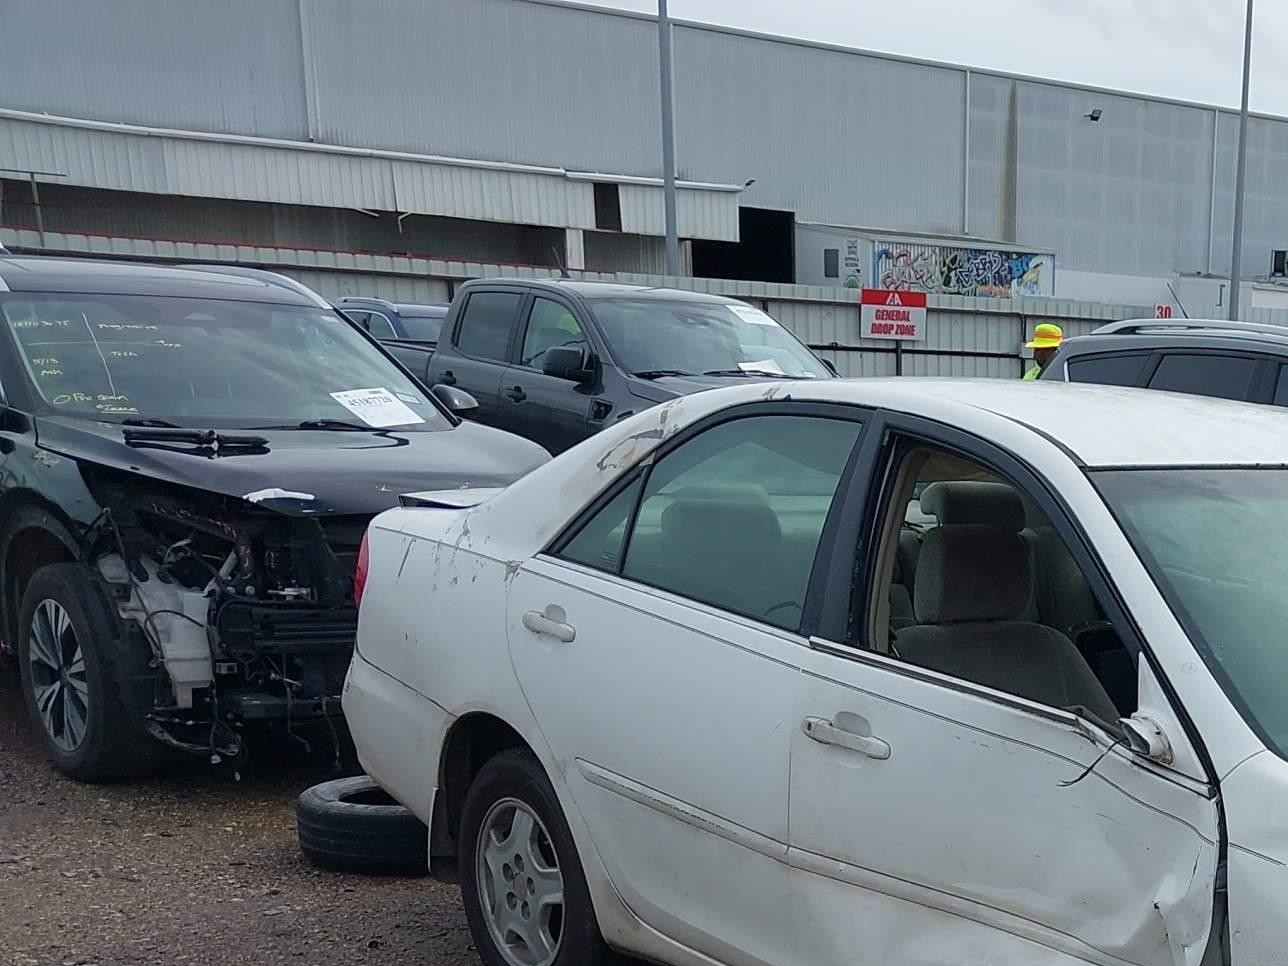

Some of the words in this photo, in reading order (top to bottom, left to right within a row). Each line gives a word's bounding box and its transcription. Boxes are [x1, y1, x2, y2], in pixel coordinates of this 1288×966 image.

[875, 309, 910, 321] GENERAL
[1157, 305, 1171, 319] 30
[871, 322, 895, 335] DROP
[895, 324, 916, 336] ZONE
